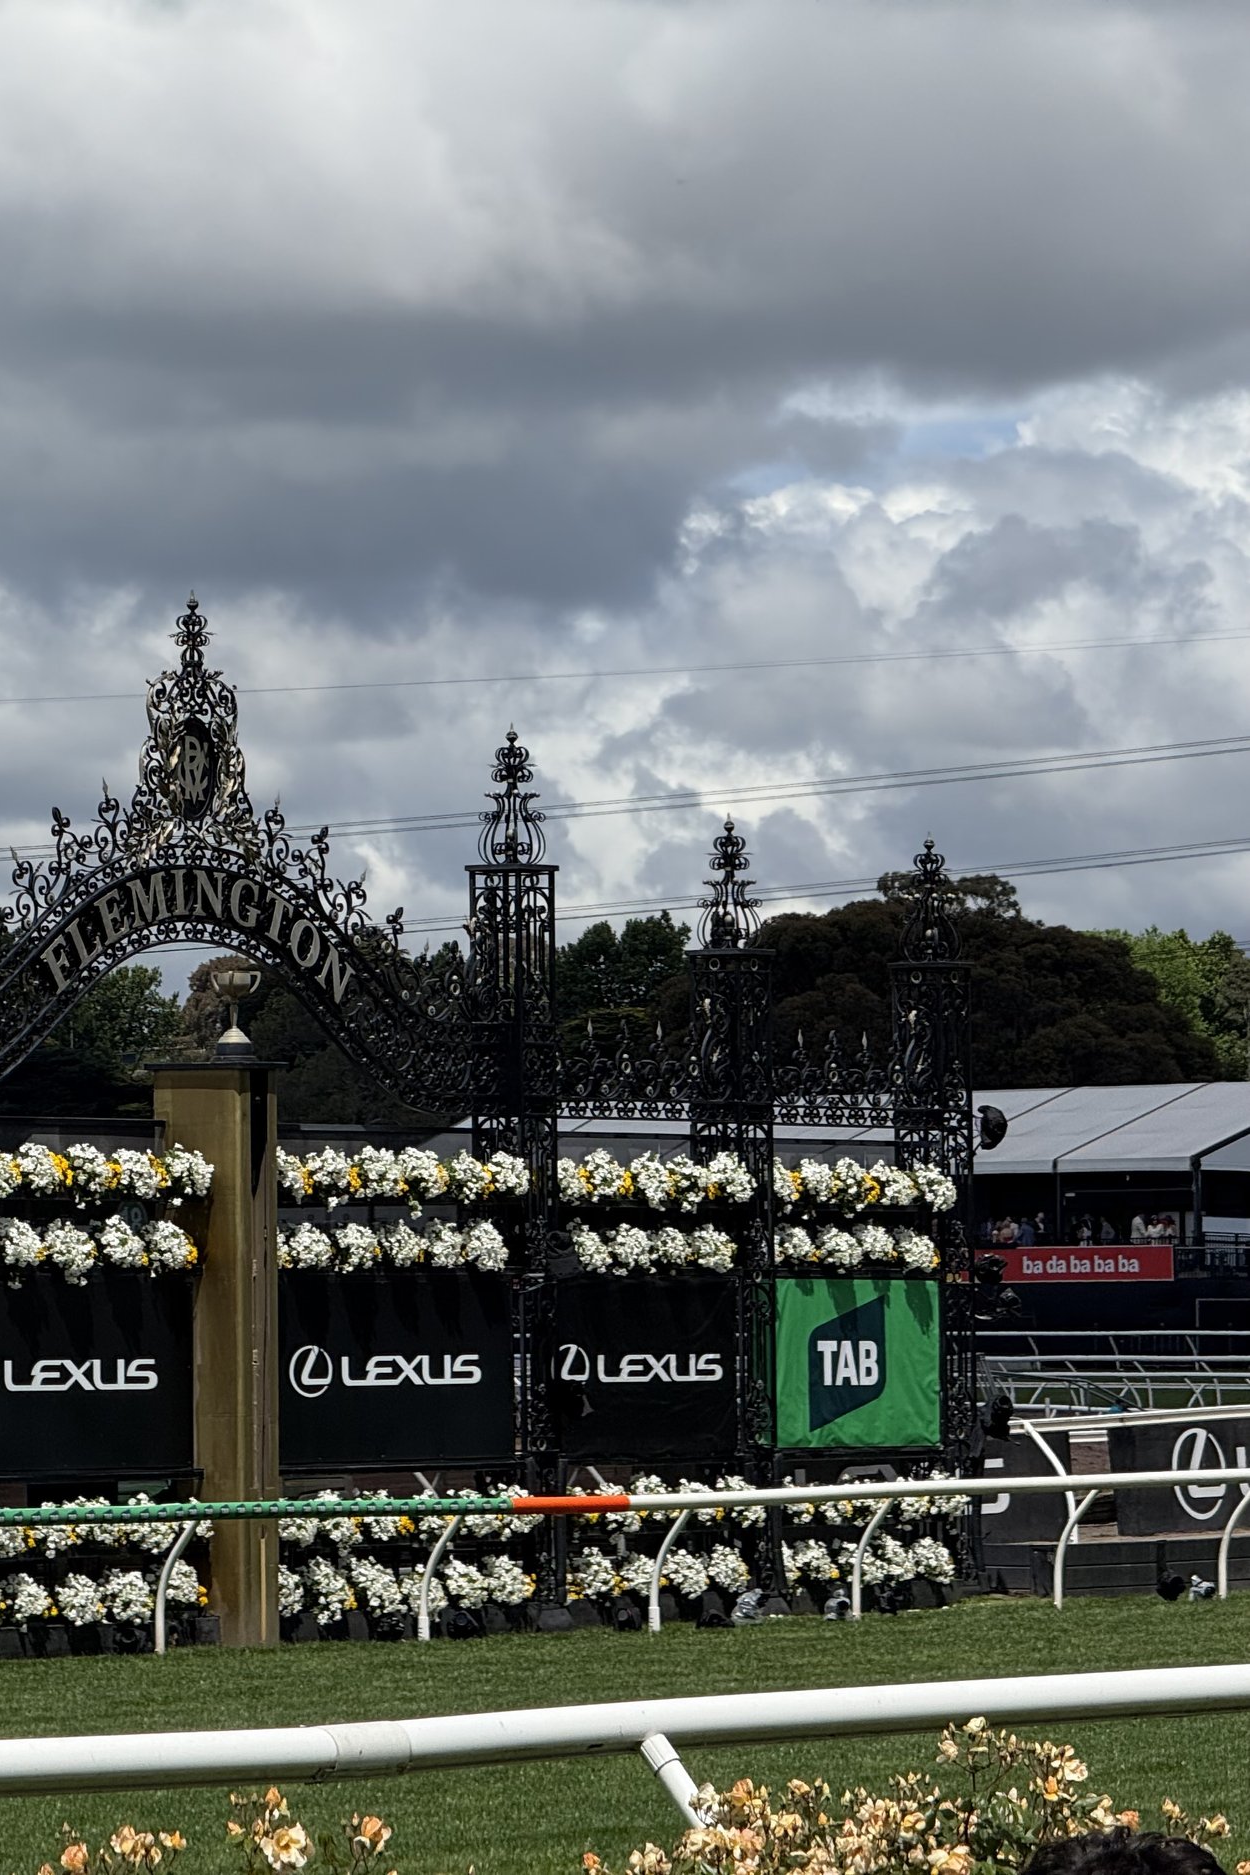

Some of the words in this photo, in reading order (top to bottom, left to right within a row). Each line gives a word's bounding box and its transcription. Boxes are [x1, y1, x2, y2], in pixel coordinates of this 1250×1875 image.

[40, 868, 356, 1004] FLEMINGTON
[1022, 1255, 1043, 1274] ba
[1046, 1255, 1066, 1274] da
[1070, 1255, 1091, 1273] ba
[1094, 1255, 1115, 1273] ba
[1118, 1254, 1139, 1273] ba
[4, 1358, 158, 1392] LEXUS
[341, 1354, 482, 1387] LEXUS
[597, 1353, 723, 1383] LEXUS
[817, 1340, 879, 1386] TAB
